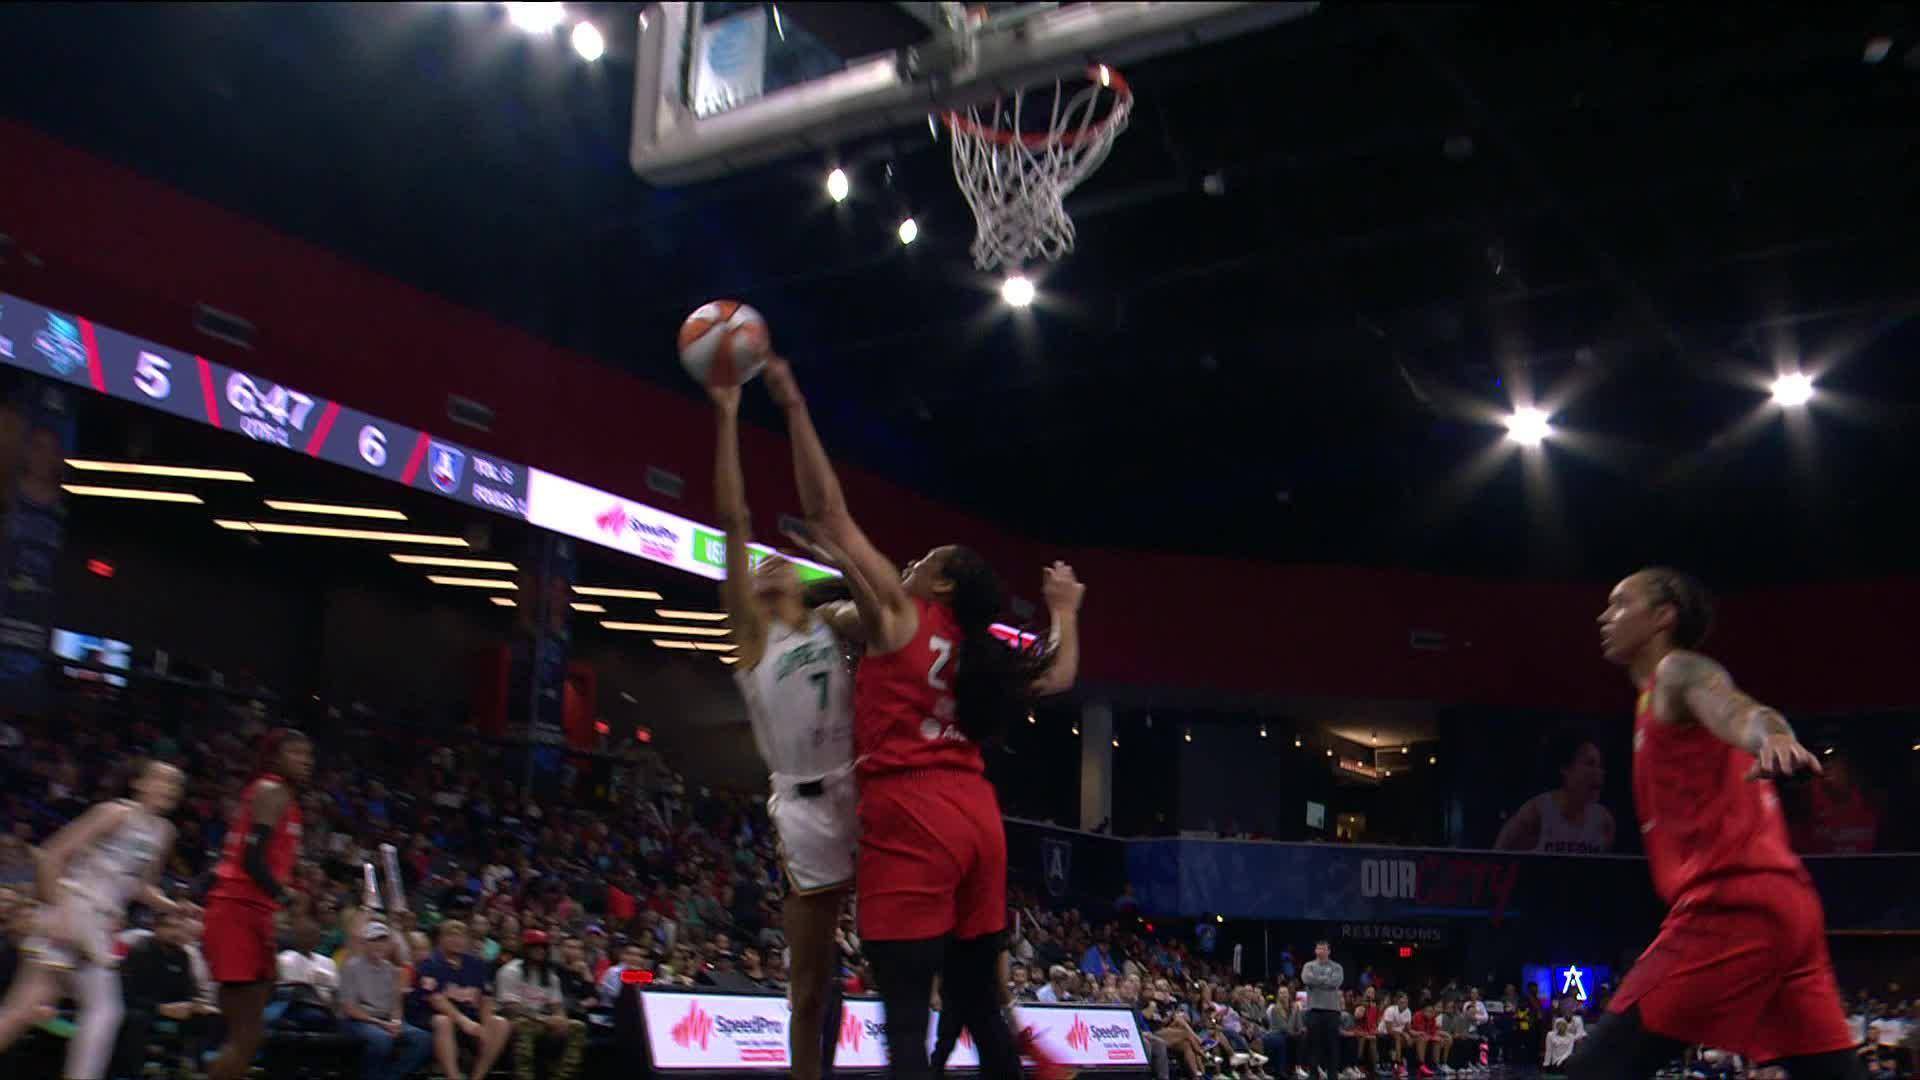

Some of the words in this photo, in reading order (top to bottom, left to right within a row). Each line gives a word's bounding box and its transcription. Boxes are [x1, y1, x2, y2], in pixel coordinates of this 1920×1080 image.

[133, 350, 171, 399] 5
[226, 370, 315, 431] 6:47
[358, 425, 388, 467] 6
[809, 671, 829, 711] 7
[1361, 858, 1417, 899] OUR
[1341, 921, 1442, 945] RESTROOMS
[714, 1014, 785, 1038] SpeedPro
[1089, 1023, 1131, 1042] SpeedPro
